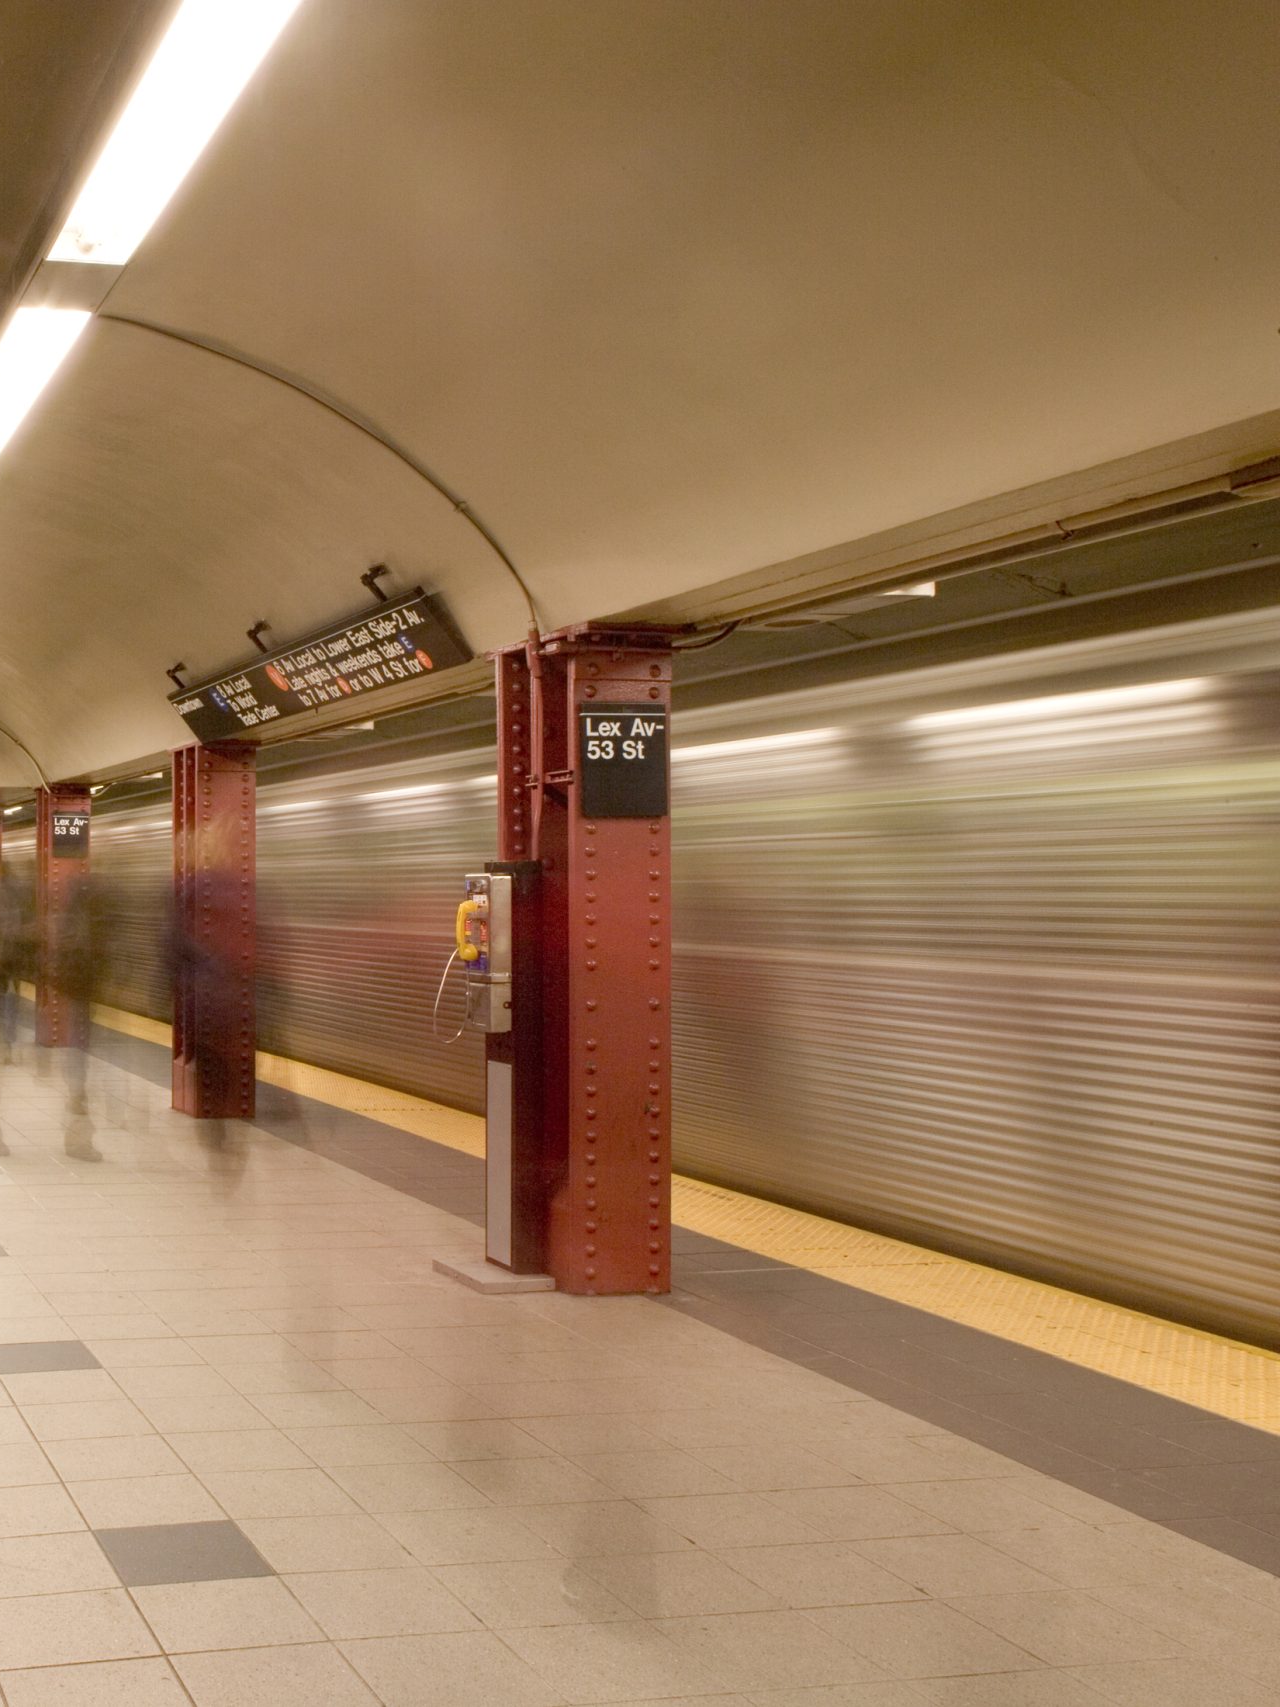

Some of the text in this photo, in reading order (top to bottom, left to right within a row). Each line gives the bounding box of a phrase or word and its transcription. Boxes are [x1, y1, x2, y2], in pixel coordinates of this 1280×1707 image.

[273, 608, 425, 675] 6 Av Local to Lower East Side-2 Av.
[284, 636, 413, 692] Late nights & weekends take E
[228, 674, 252, 693] Local
[297, 693, 312, 707] to
[306, 690, 318, 704] 7
[314, 688, 329, 702] Av
[324, 683, 342, 698] for
[349, 679, 363, 692] or
[357, 674, 374, 688] to
[367, 667, 385, 684] W
[382, 664, 395, 680] 4
[389, 660, 409, 678] St
[402, 657, 424, 674] for
[226, 691, 258, 712] To World
[237, 705, 280, 727] Trade Center
[586, 717, 664, 736] Lex Av-
[587, 740, 645, 760] 53 St
[54, 818, 89, 826] Lex Av-
[55, 826, 80, 835] 53 St
